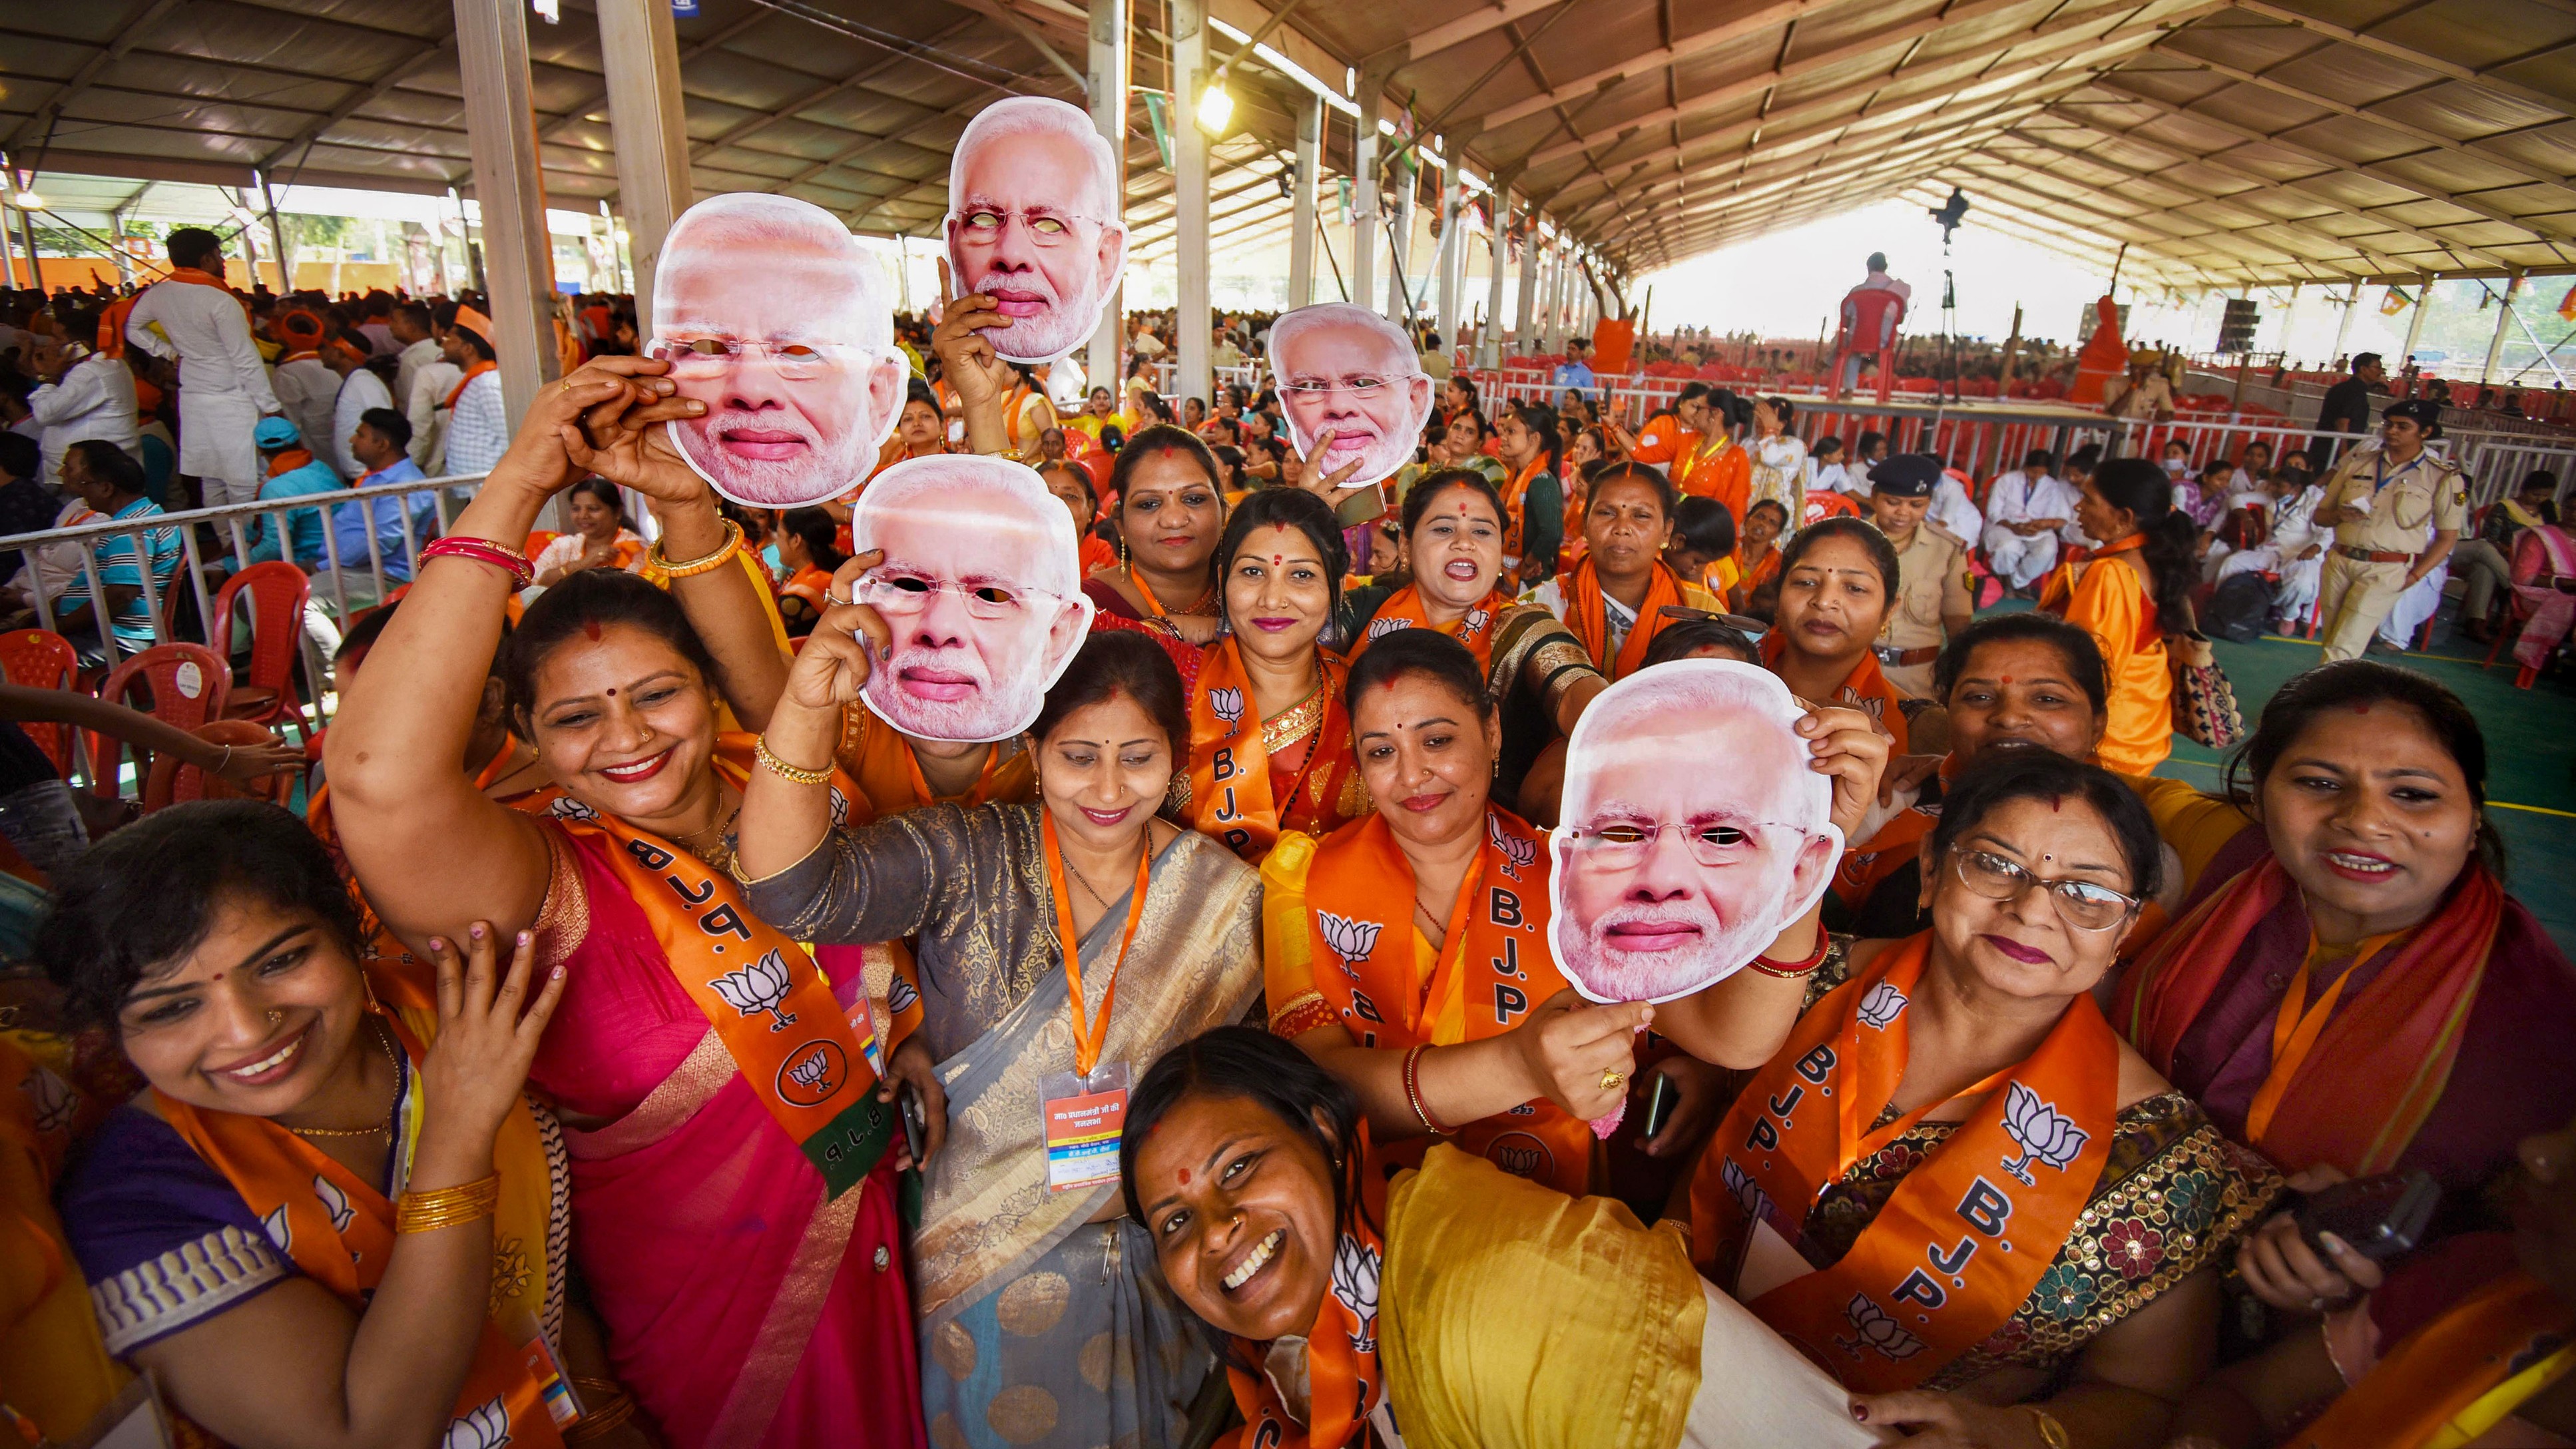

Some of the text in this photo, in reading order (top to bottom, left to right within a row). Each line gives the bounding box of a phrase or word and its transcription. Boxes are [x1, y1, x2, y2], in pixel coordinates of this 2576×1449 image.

[1068, 1106, 1099, 1119] प्रधानमंत्री
[1101, 1104, 1109, 1114] जी
[1110, 1102, 1119, 1112] की
[1074, 1118, 1101, 1127] जनसभा
[1744, 1042, 1837, 1171] B.J.P.
[1890, 1174, 2013, 1324] B.J.P.
